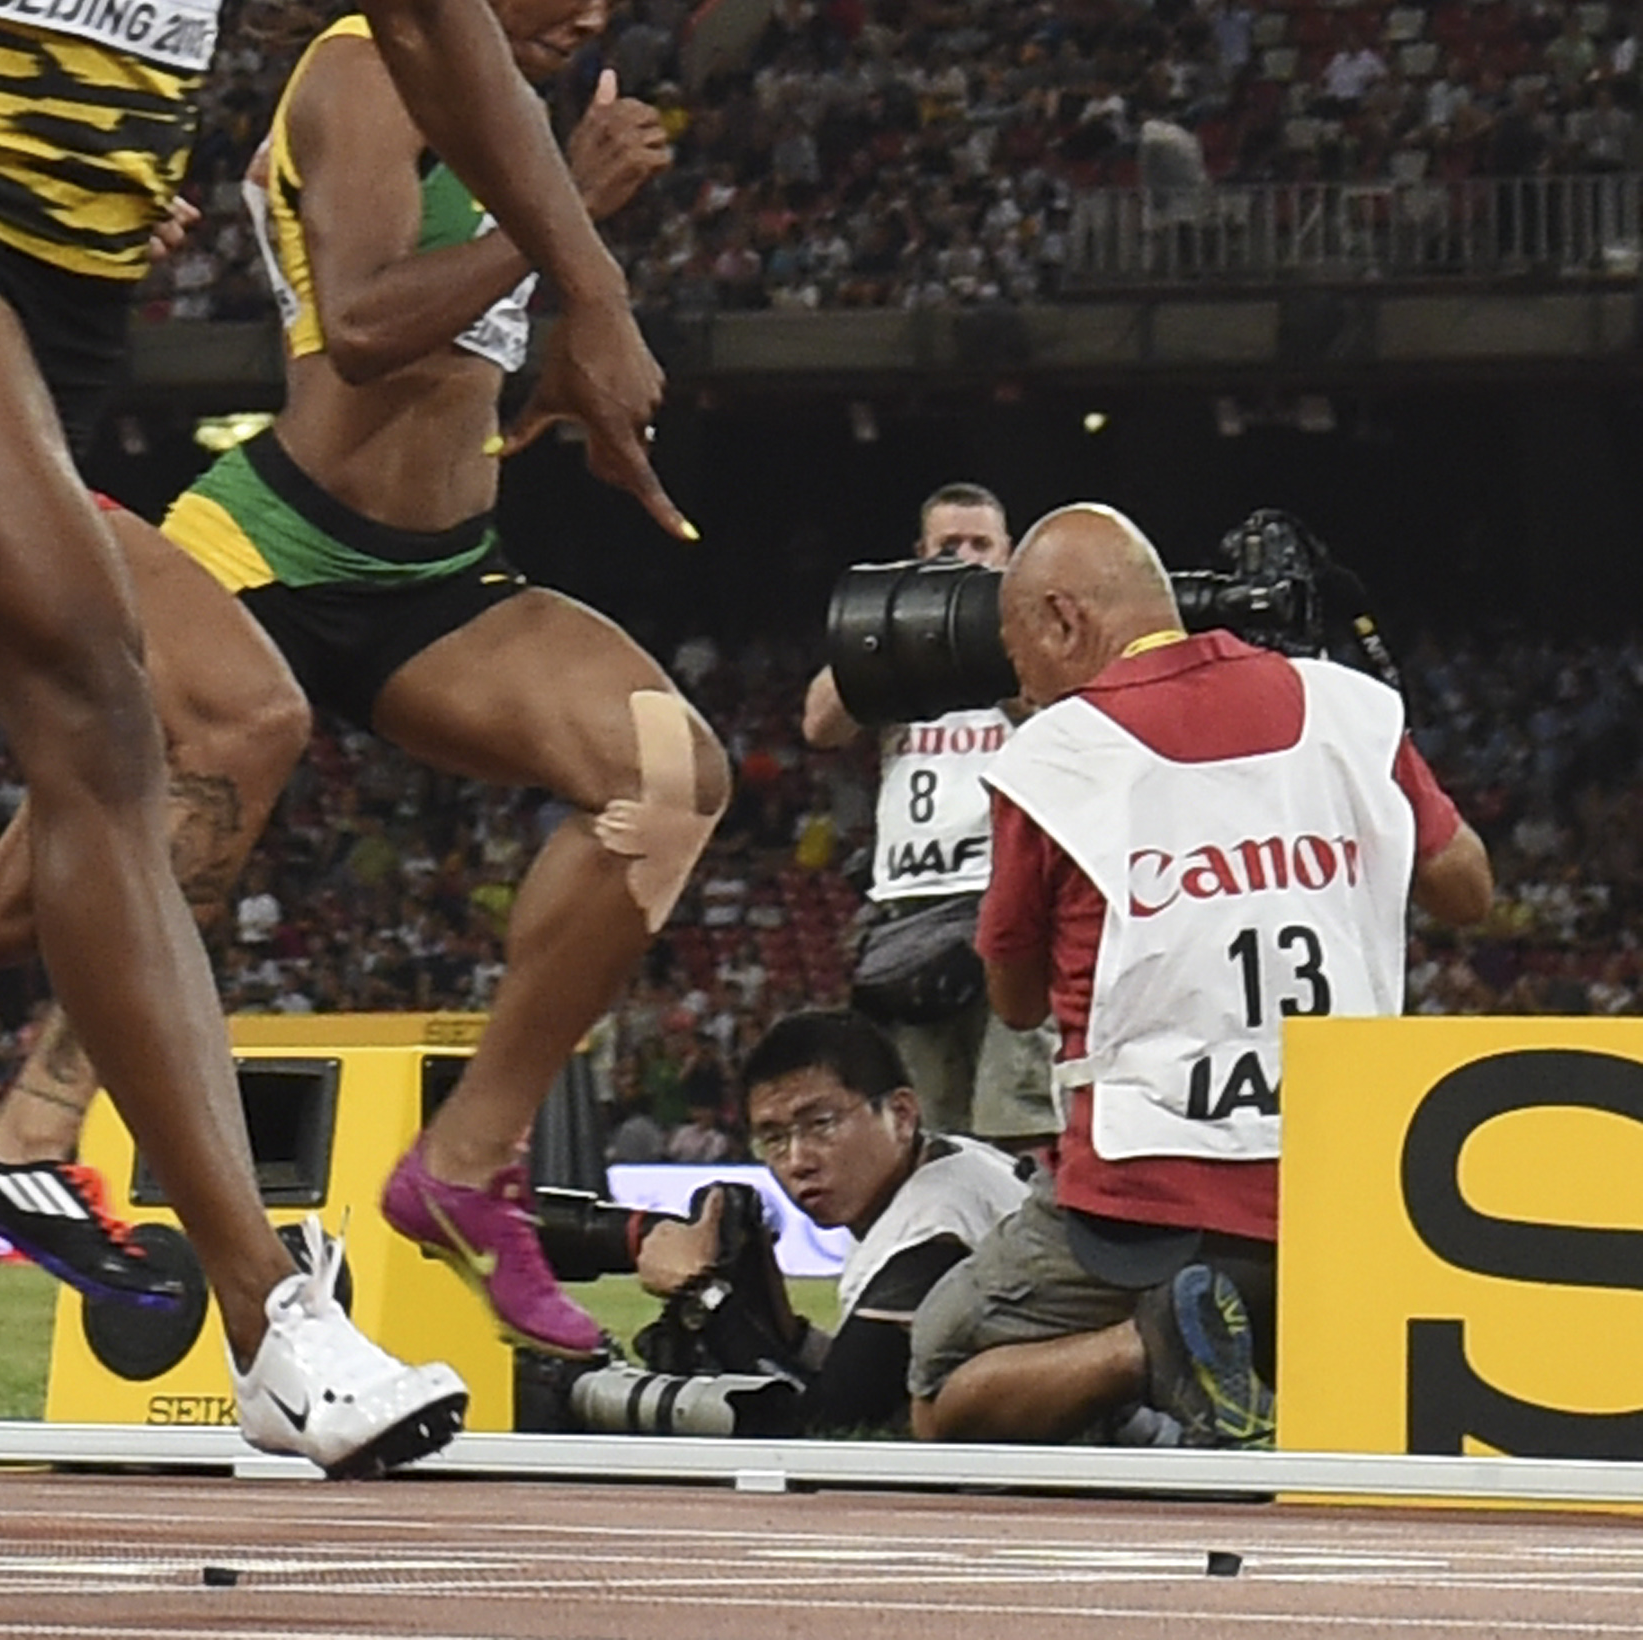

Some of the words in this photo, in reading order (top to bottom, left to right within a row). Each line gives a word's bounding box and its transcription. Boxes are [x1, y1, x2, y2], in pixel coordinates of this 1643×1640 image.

[897, 723, 1006, 758] anon
[909, 769, 937, 824] 8
[888, 835, 989, 881] IAAF
[1228, 925, 1331, 1028] 13
[146, 1396, 237, 1426] SEIK
